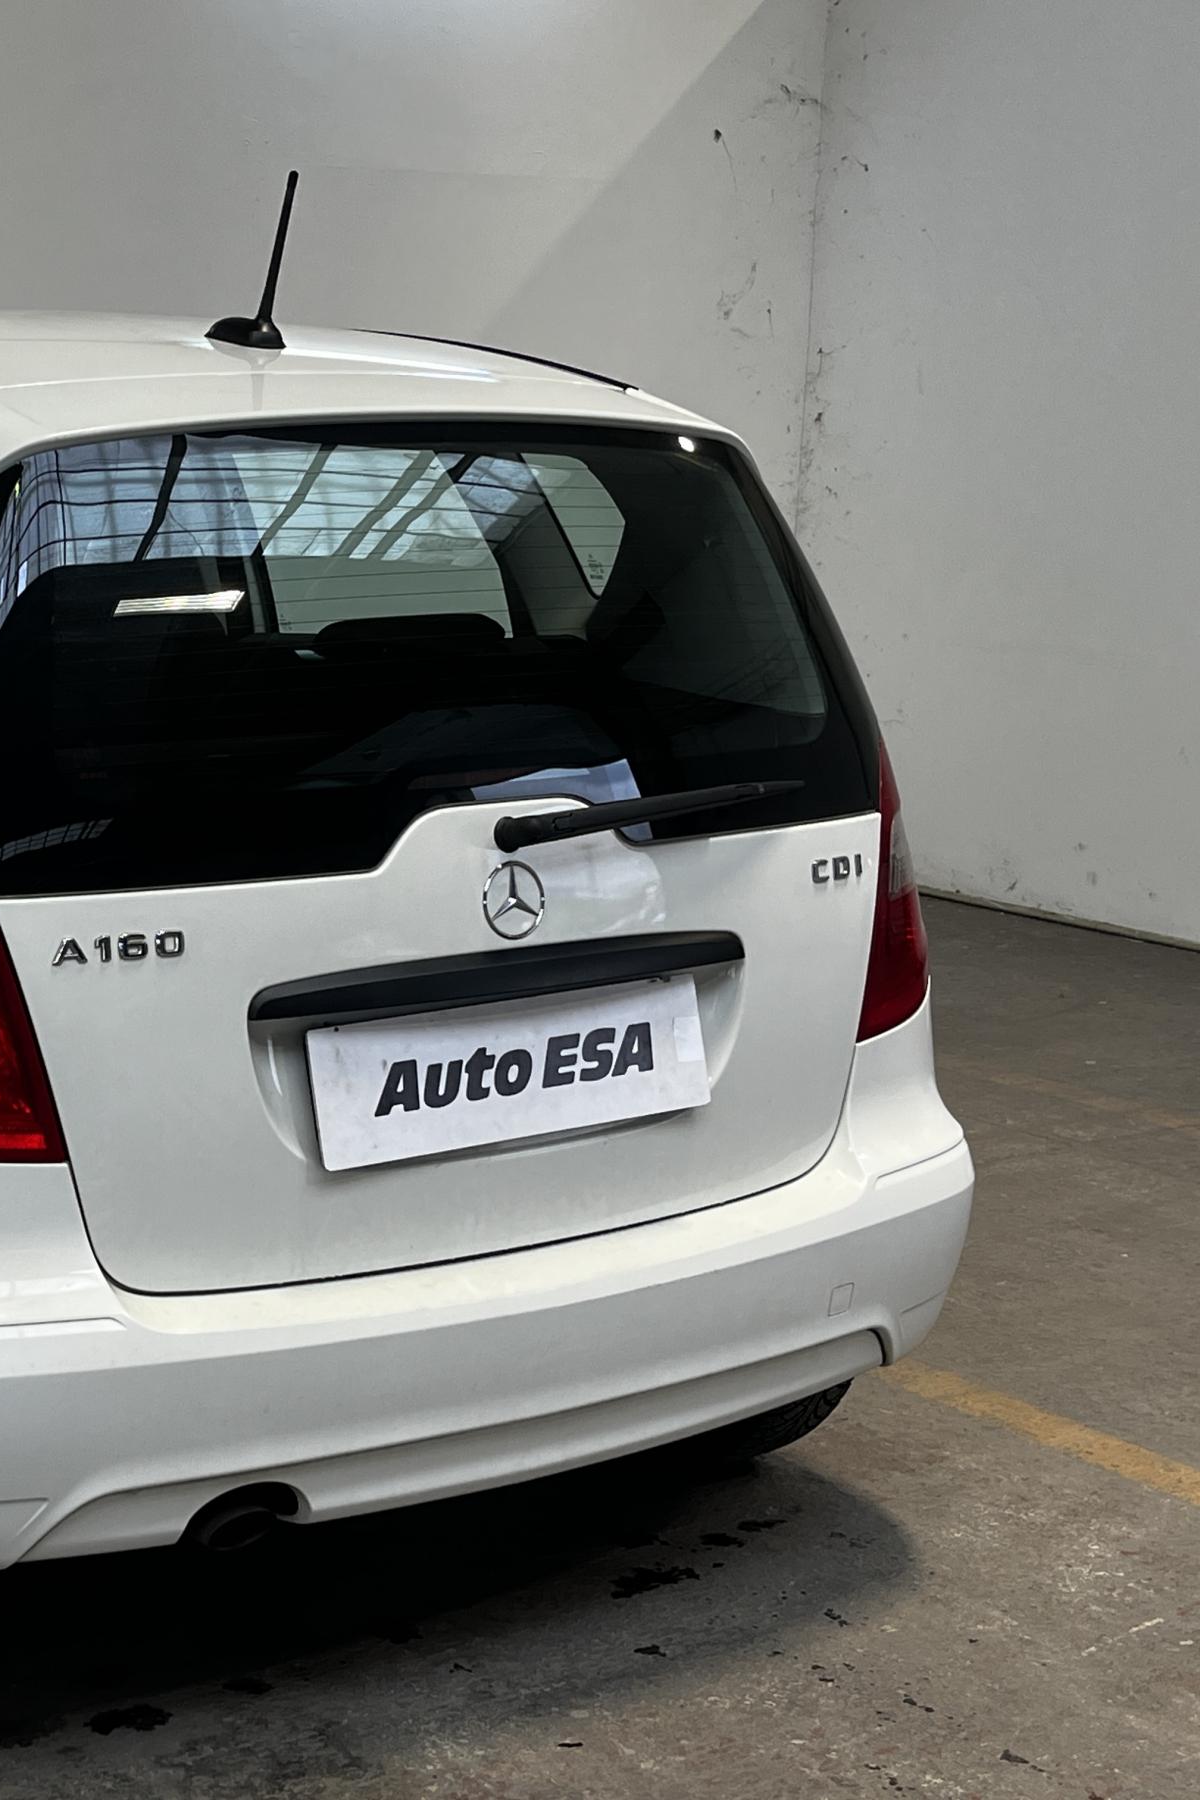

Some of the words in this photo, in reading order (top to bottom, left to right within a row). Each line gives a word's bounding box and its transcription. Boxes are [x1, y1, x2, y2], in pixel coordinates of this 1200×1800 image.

[811, 853, 863, 884] CDI
[374, 1046, 533, 1117] Auto
[542, 1021, 654, 1088] ESA
